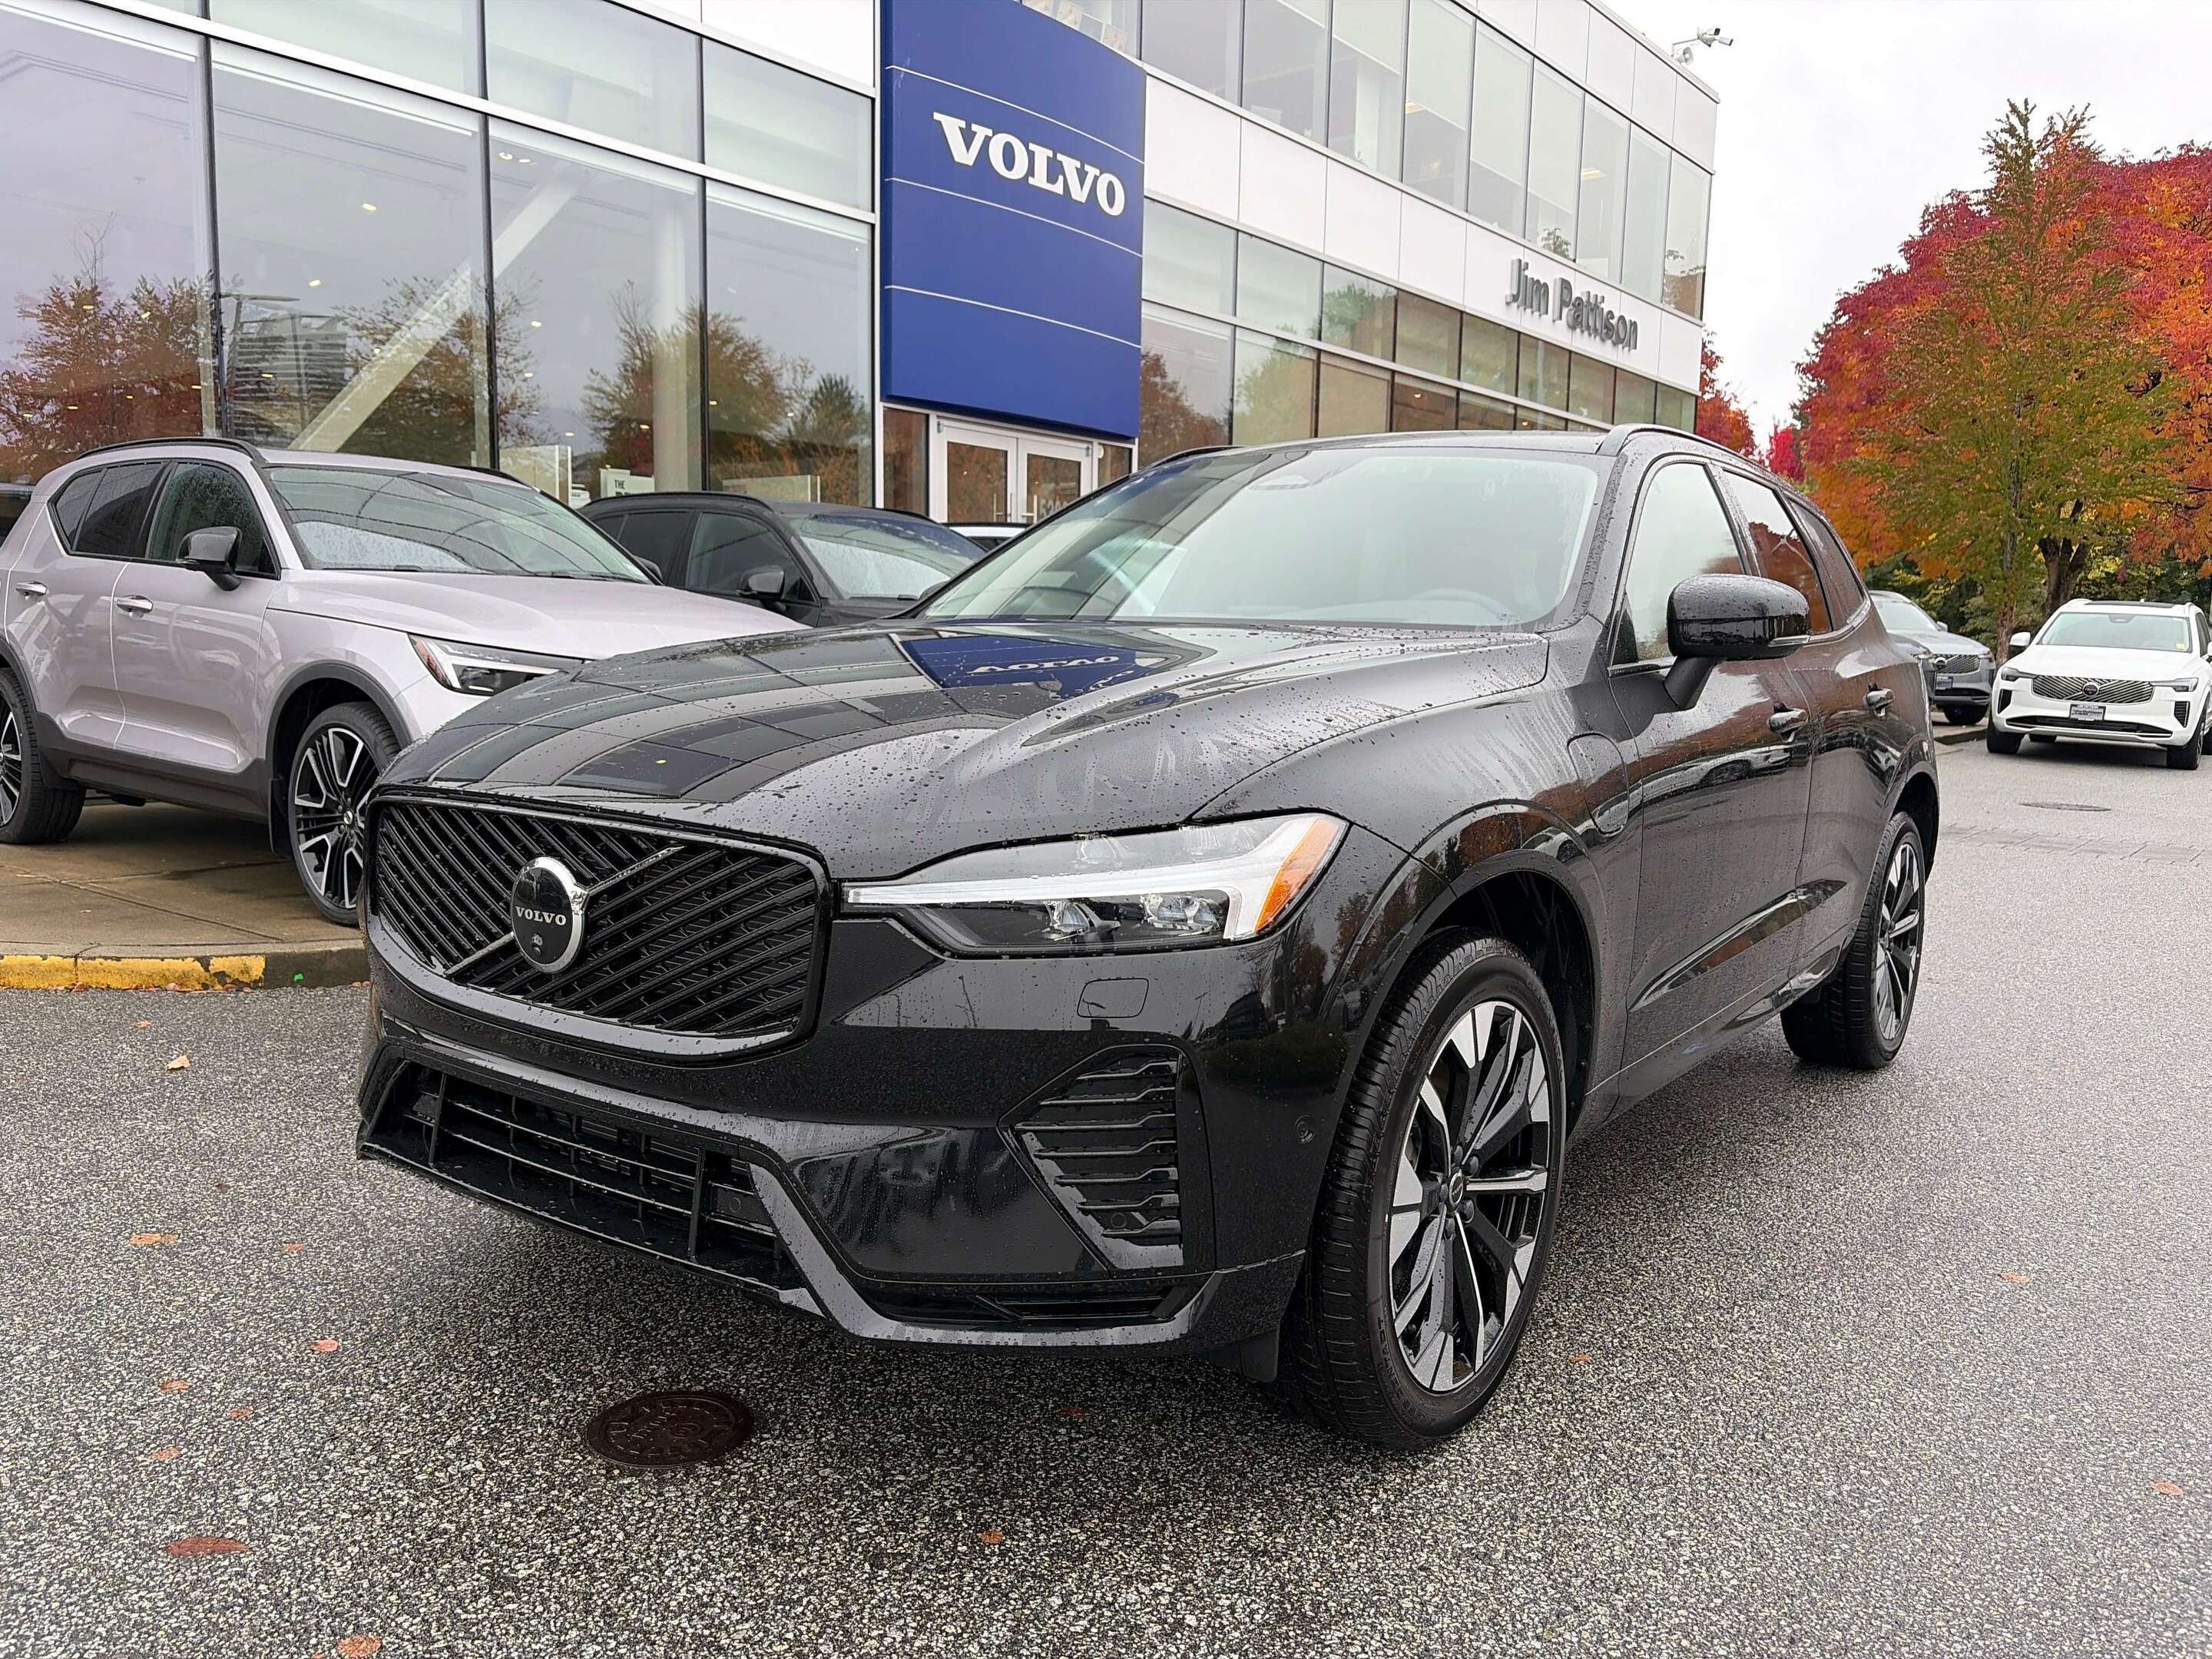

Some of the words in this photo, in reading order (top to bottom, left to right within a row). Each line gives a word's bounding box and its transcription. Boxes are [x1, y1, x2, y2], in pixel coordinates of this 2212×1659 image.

[933, 111, 1125, 217] VOLVO
[1505, 258, 1549, 316] Jim
[1552, 277, 1638, 351] Pattison
[614, 479, 626, 490] THE
[515, 906, 567, 926] VOLVO
